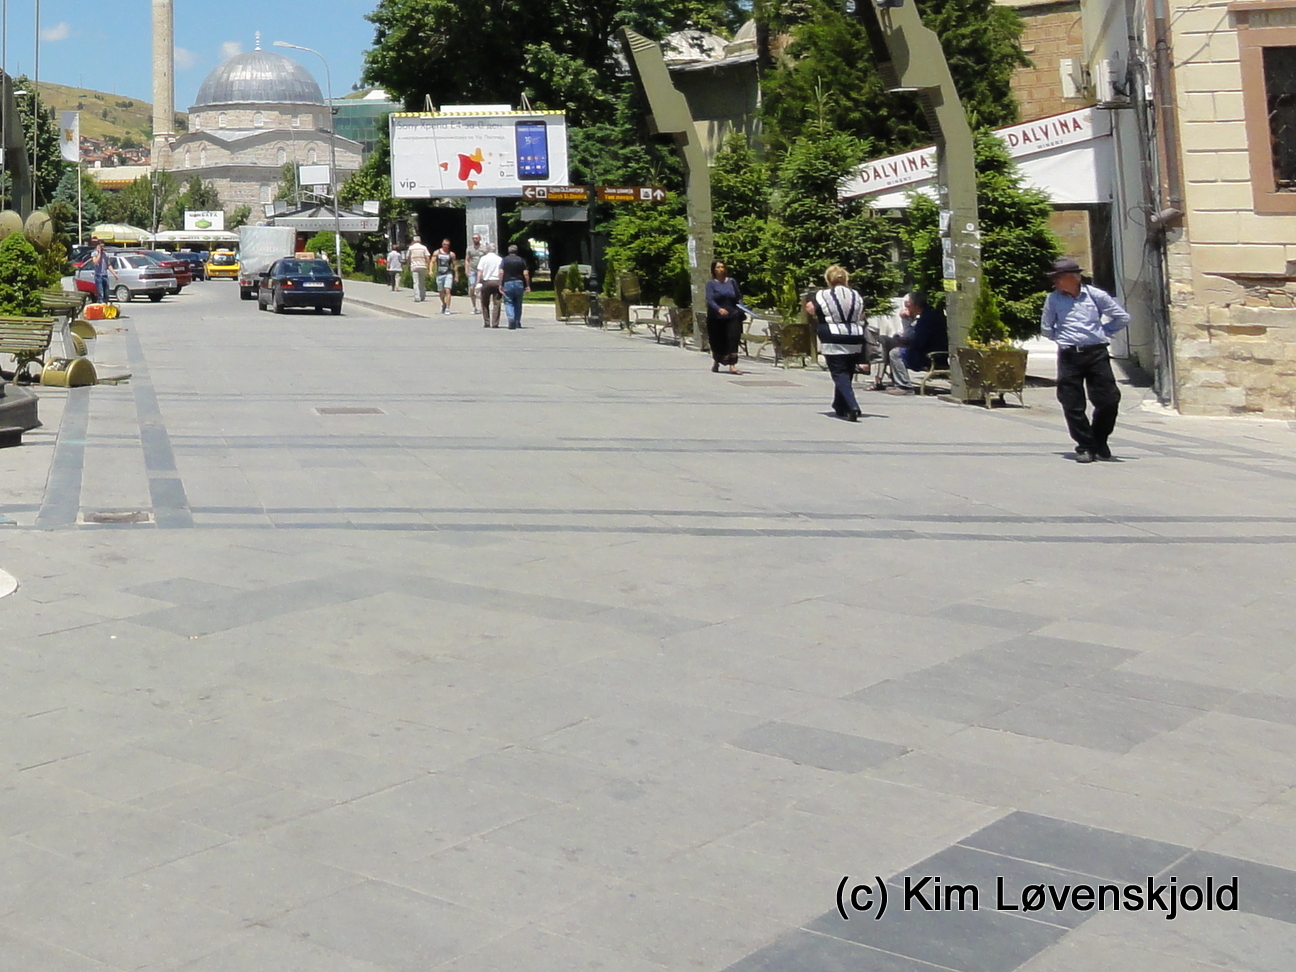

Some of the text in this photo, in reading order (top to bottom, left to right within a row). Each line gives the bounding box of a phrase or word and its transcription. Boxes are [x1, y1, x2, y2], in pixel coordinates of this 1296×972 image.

[397, 120, 417, 131] Sony
[1007, 116, 1084, 148] DALVINA
[1036, 139, 1065, 150] WINERY
[860, 154, 930, 184] DALVINA
[399, 178, 417, 191] vip
[886, 176, 913, 186] WINERY
